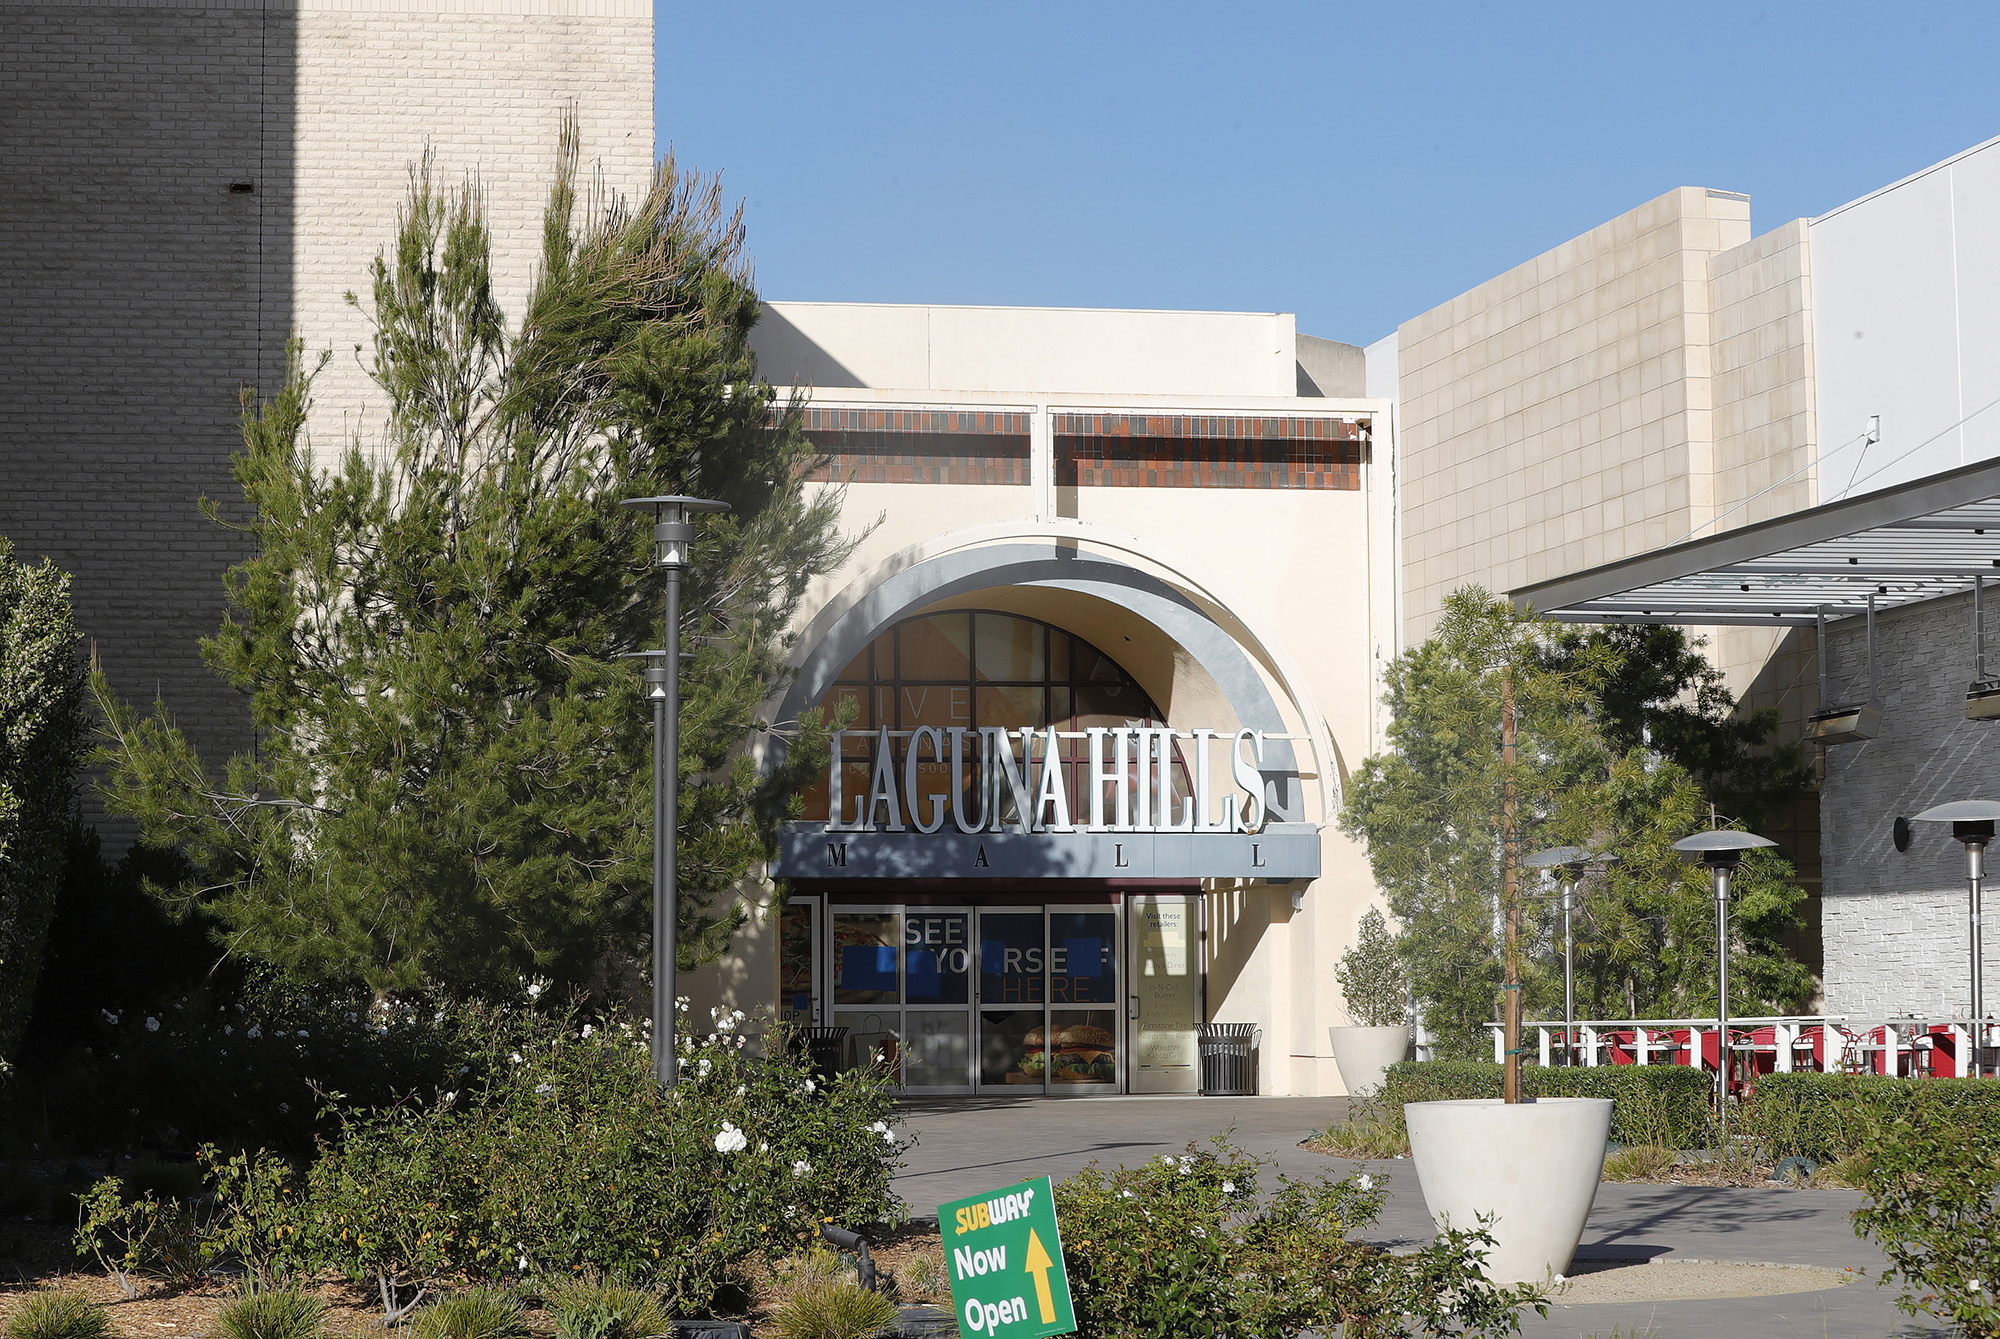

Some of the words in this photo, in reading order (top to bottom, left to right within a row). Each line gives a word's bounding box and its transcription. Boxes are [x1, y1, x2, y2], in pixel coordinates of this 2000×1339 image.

[824, 724, 1074, 834] LAGUNA
[1084, 726, 1265, 834] HILLS
[905, 918, 963, 945] SEE
[1146, 912, 1161, 920] Visit
[1162, 912, 1181, 920] these
[1150, 920, 1179, 928] retailers:
[955, 1187, 1035, 1237] SUBWAY
[953, 1245, 1006, 1280] Now
[965, 1296, 1028, 1337] Open
